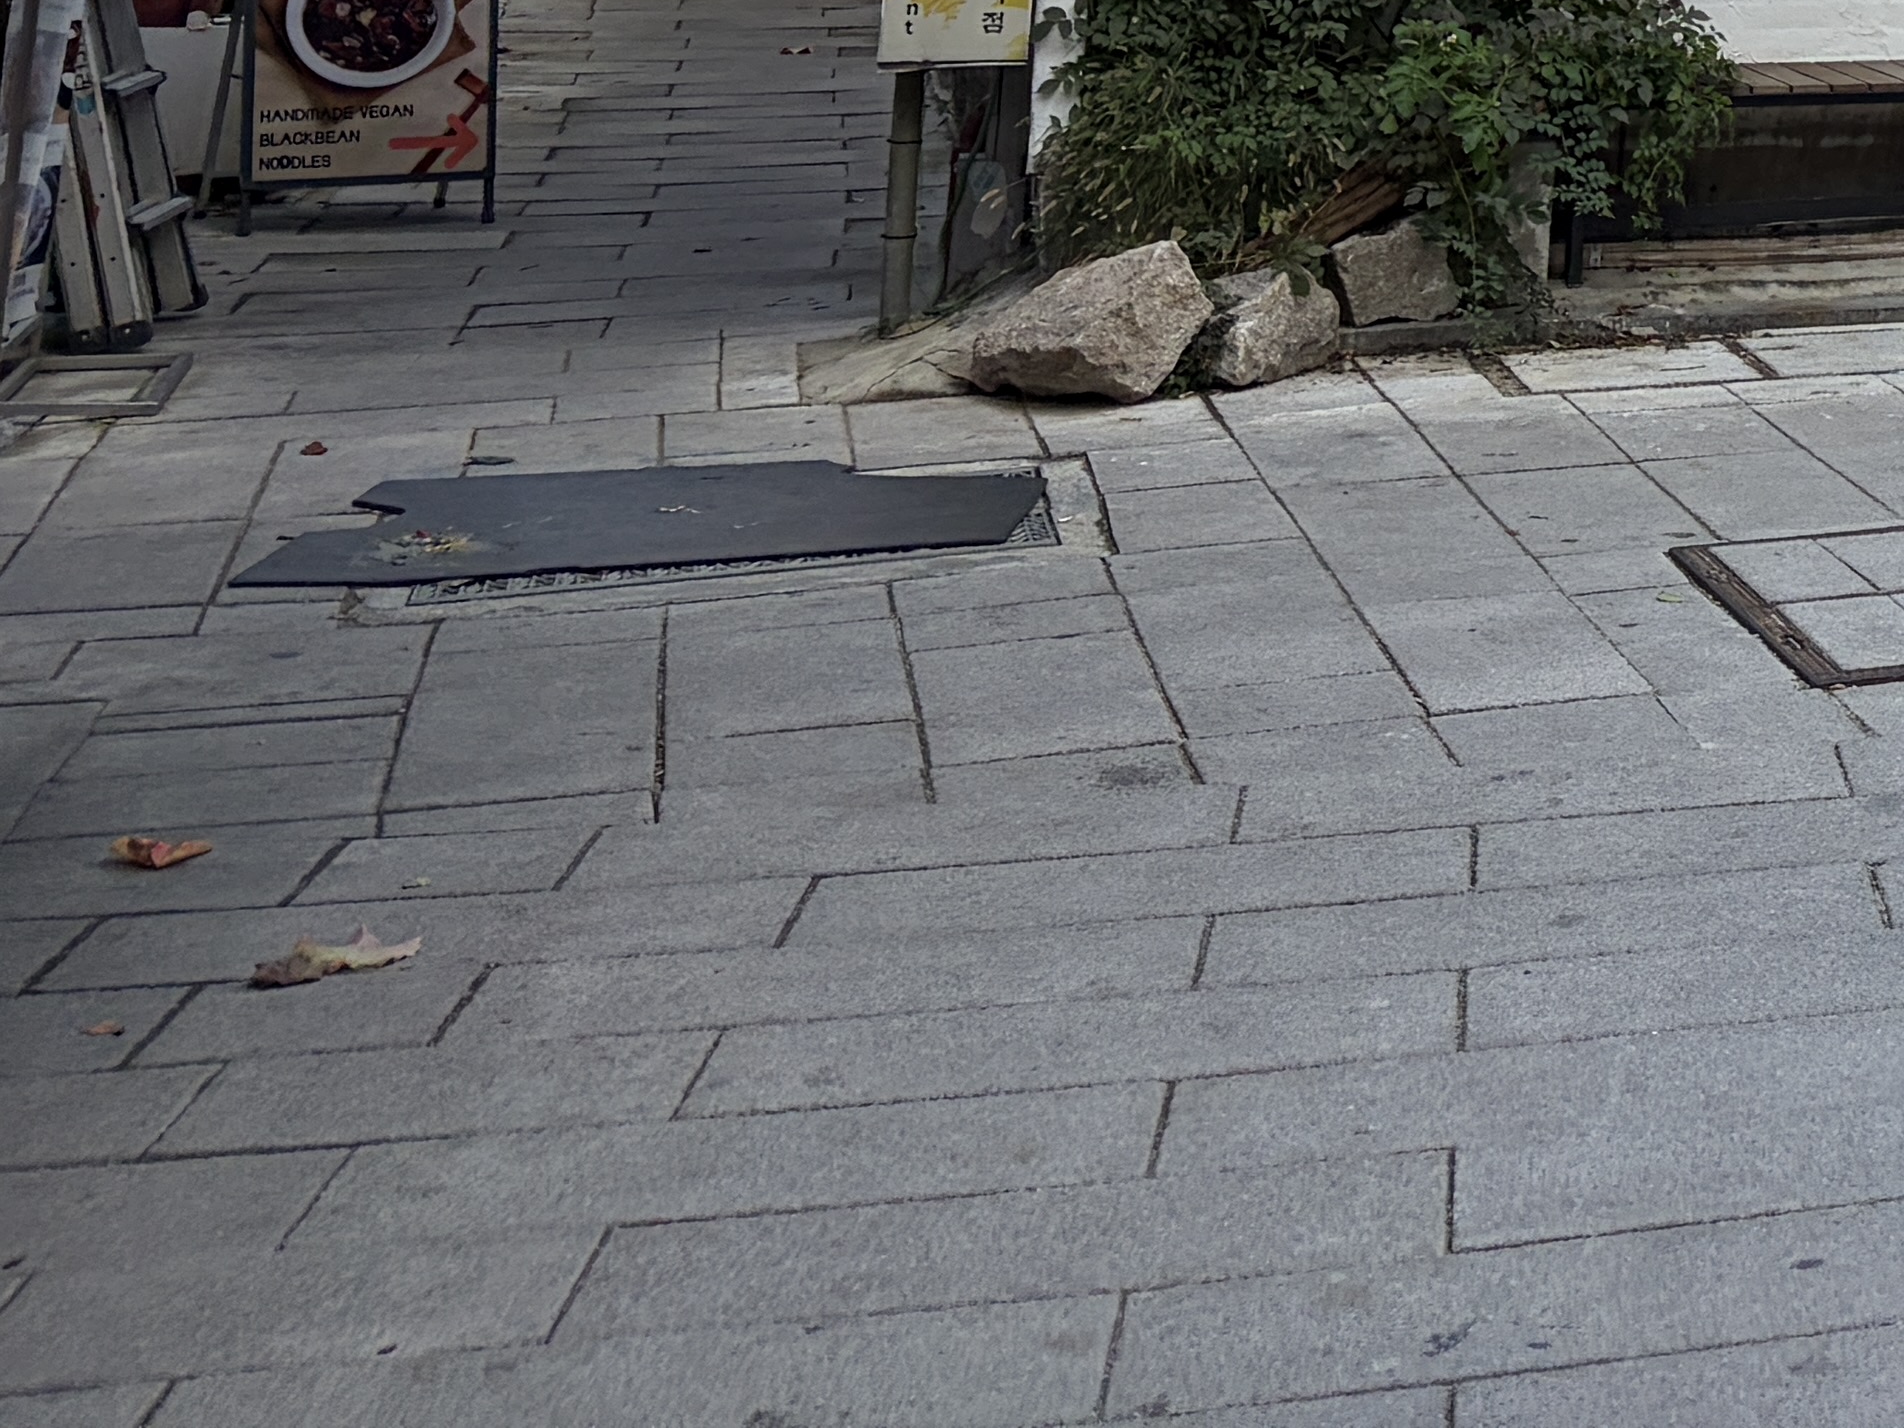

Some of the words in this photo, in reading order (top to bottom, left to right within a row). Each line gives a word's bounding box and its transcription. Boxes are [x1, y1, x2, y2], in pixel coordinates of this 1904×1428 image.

[260, 106, 354, 124] HANDMADE
[361, 104, 414, 120] VEGAN
[259, 130, 361, 148] BLACKBEAN
[259, 154, 332, 171] NOODLES
